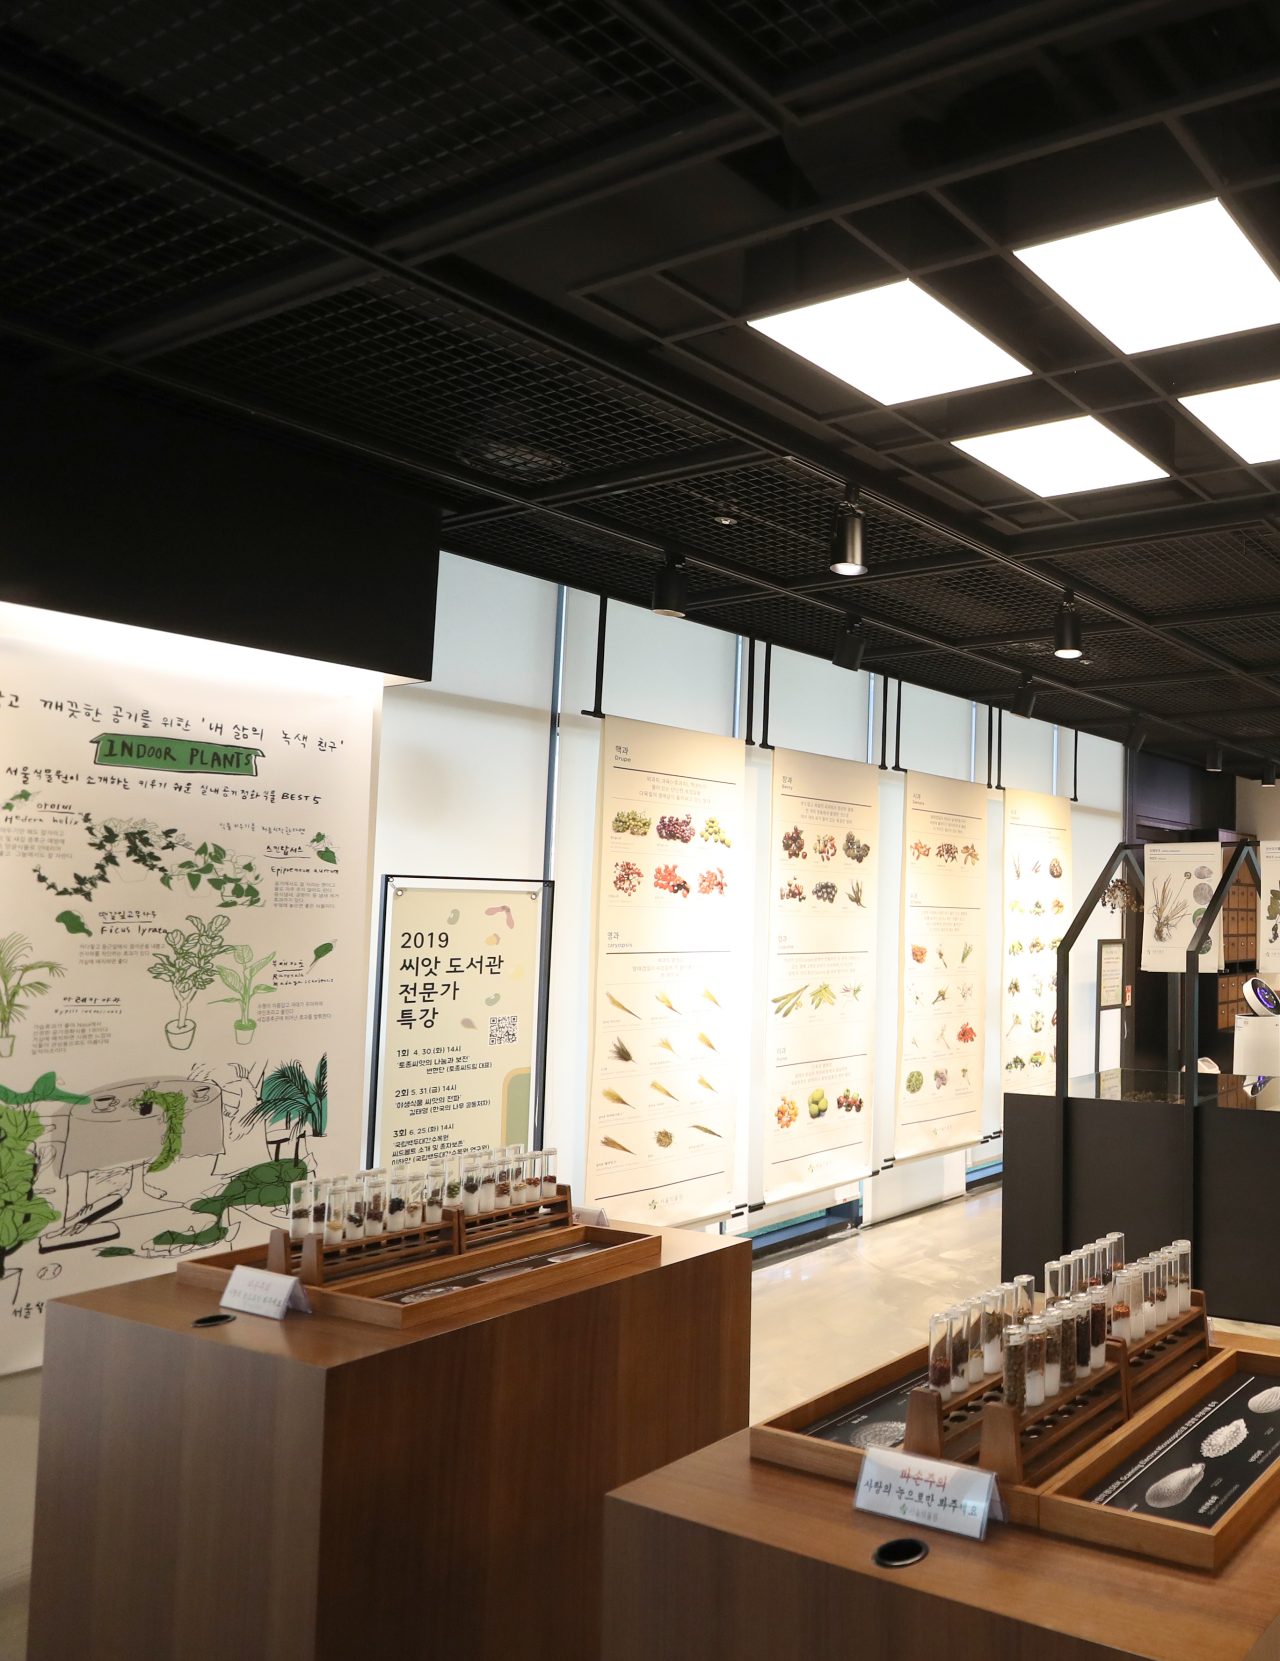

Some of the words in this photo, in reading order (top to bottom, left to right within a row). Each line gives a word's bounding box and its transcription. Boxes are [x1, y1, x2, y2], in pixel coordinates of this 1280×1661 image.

[0, 690, 19, 708] 고
[40, 699, 102, 722] 깨끗한
[112, 705, 152, 728] 공기를
[161, 717, 191, 732] 위한
[232, 724, 264, 741] 삶의
[282, 730, 307, 749] 녹색
[104, 739, 177, 762] INDOOR
[189, 747, 252, 769] PLANTS
[5, 766, 79, 785] 서울식물원이
[86, 775, 131, 790] 소개하는
[138, 779, 168, 789] 키우기
[173, 782, 192, 794] 쉬운
[101, 925, 130, 934] Ficus
[138, 924, 168, 936] lyrata
[400, 931, 449, 949] 2019
[400, 956, 441, 977] 씨앗
[445, 954, 504, 976] 도서관
[398, 981, 460, 1004] 전문가
[396, 1008, 439, 1030] 특강
[397, 1049, 409, 1057] 1회
[395, 1089, 409, 1098] 2회
[442, 1084, 457, 1092] 14시
[452, 1103, 464, 1111] 나무
[393, 1129, 407, 1138] 3회
[900, 1467, 948, 1492] 파손주의
[864, 1478, 892, 1495] 사랑의
[896, 1486, 934, 1507] 눈으로만
